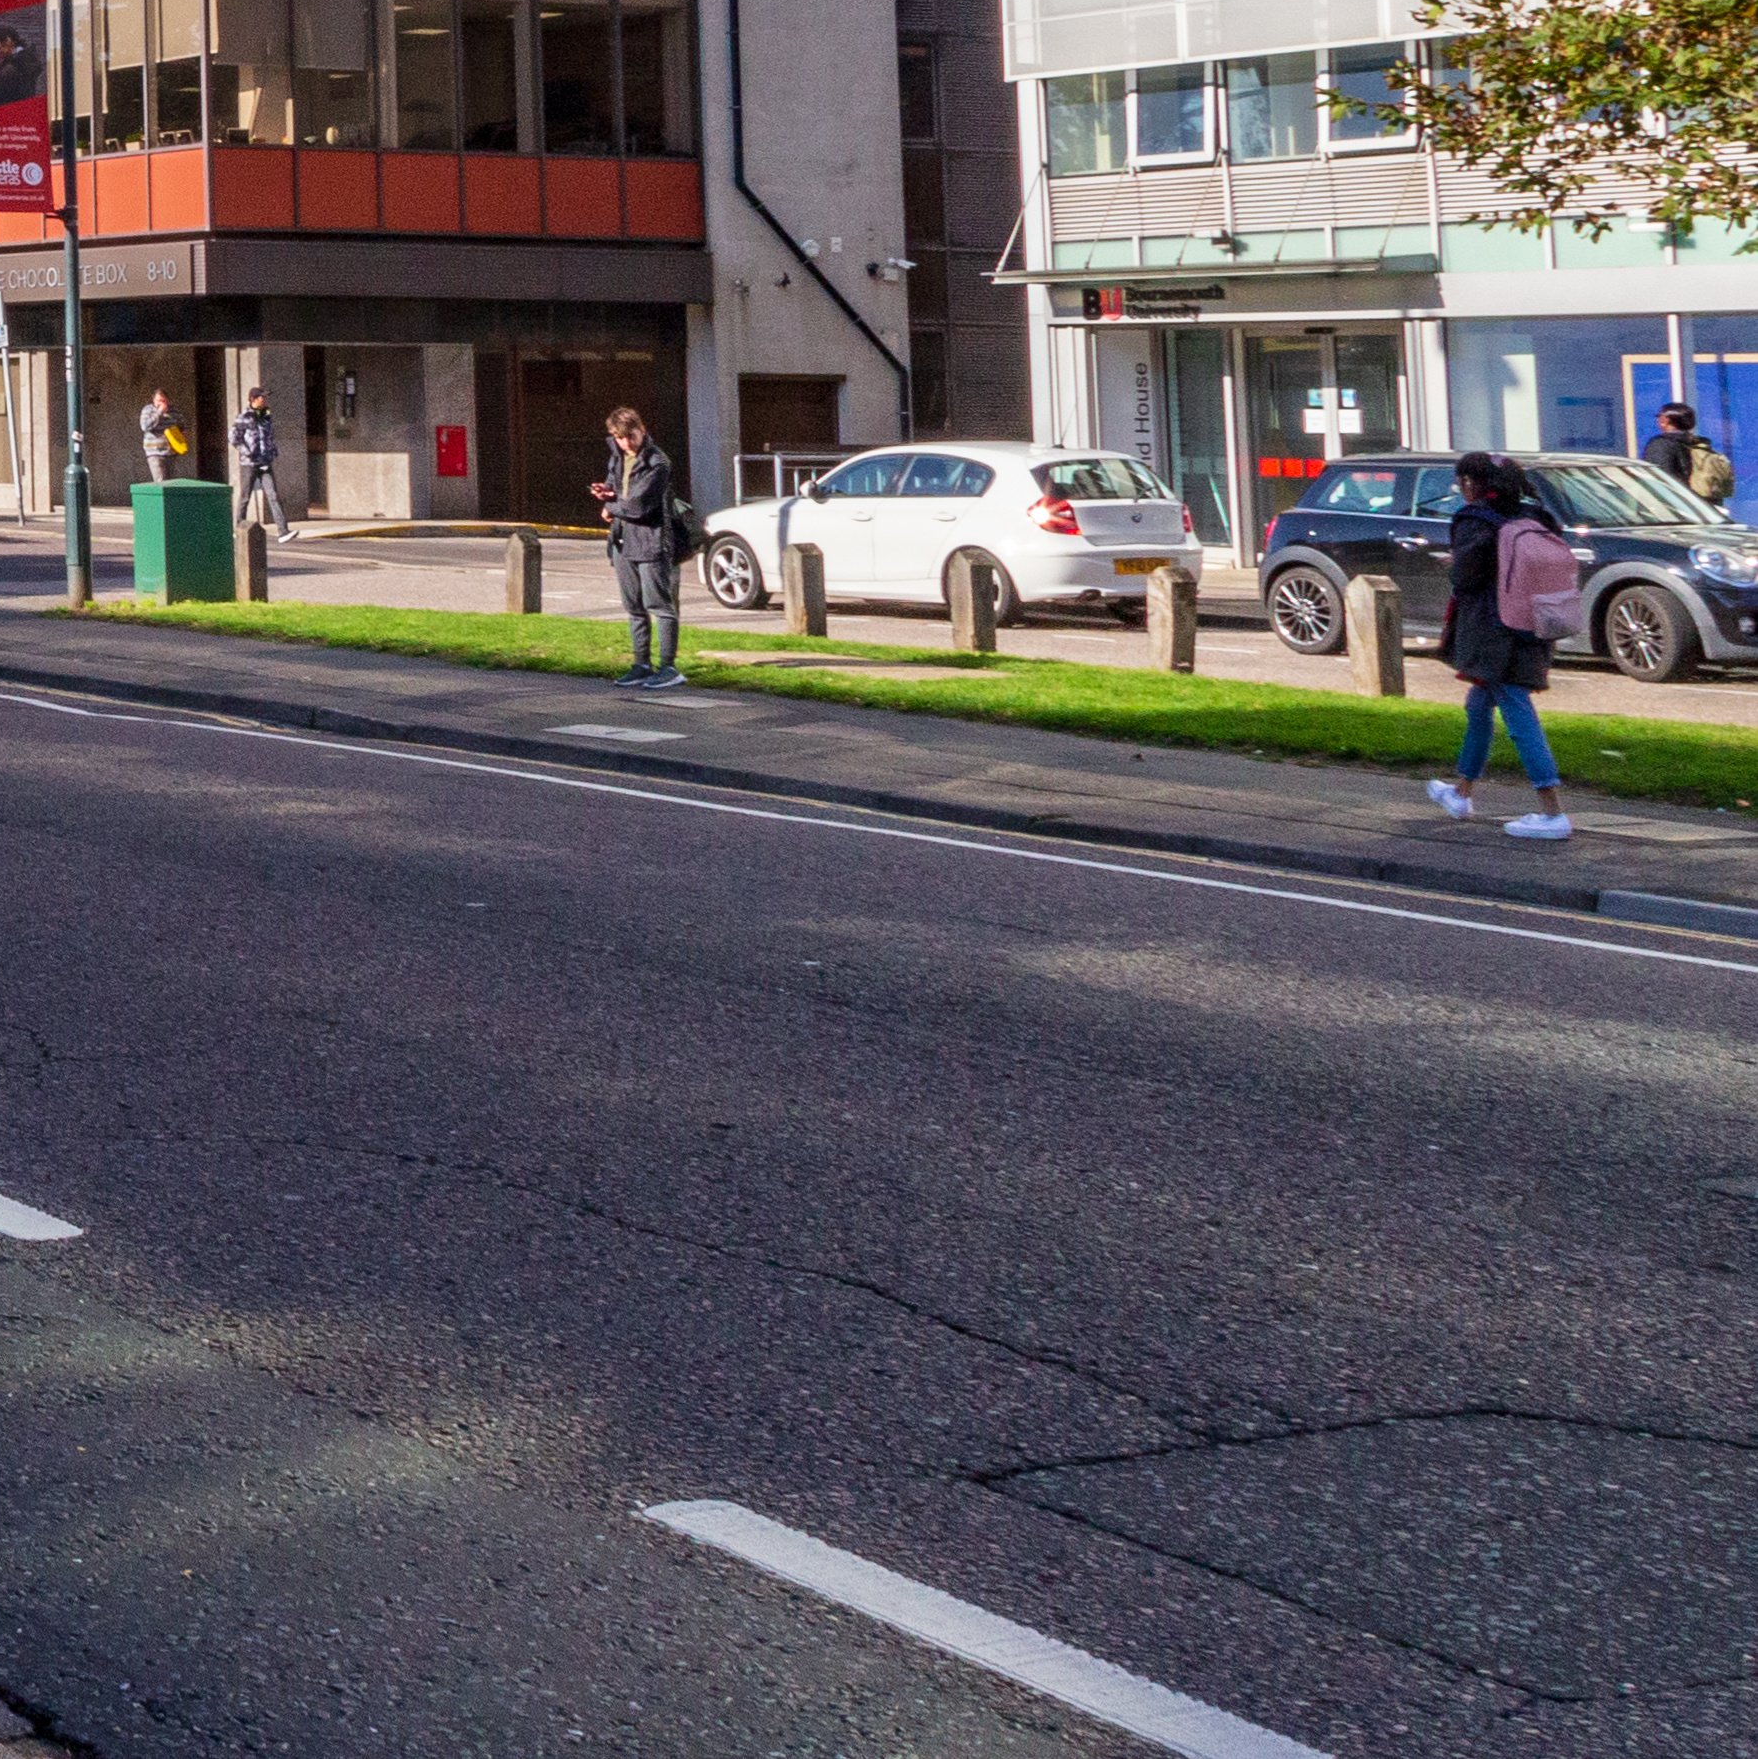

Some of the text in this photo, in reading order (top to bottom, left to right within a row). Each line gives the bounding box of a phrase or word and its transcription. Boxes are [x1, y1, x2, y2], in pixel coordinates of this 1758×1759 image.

[96, 262, 128, 284] BOX
[146, 259, 178, 281] 8-10
[1083, 286, 1123, 321] BU
[1134, 362, 1151, 434] House
